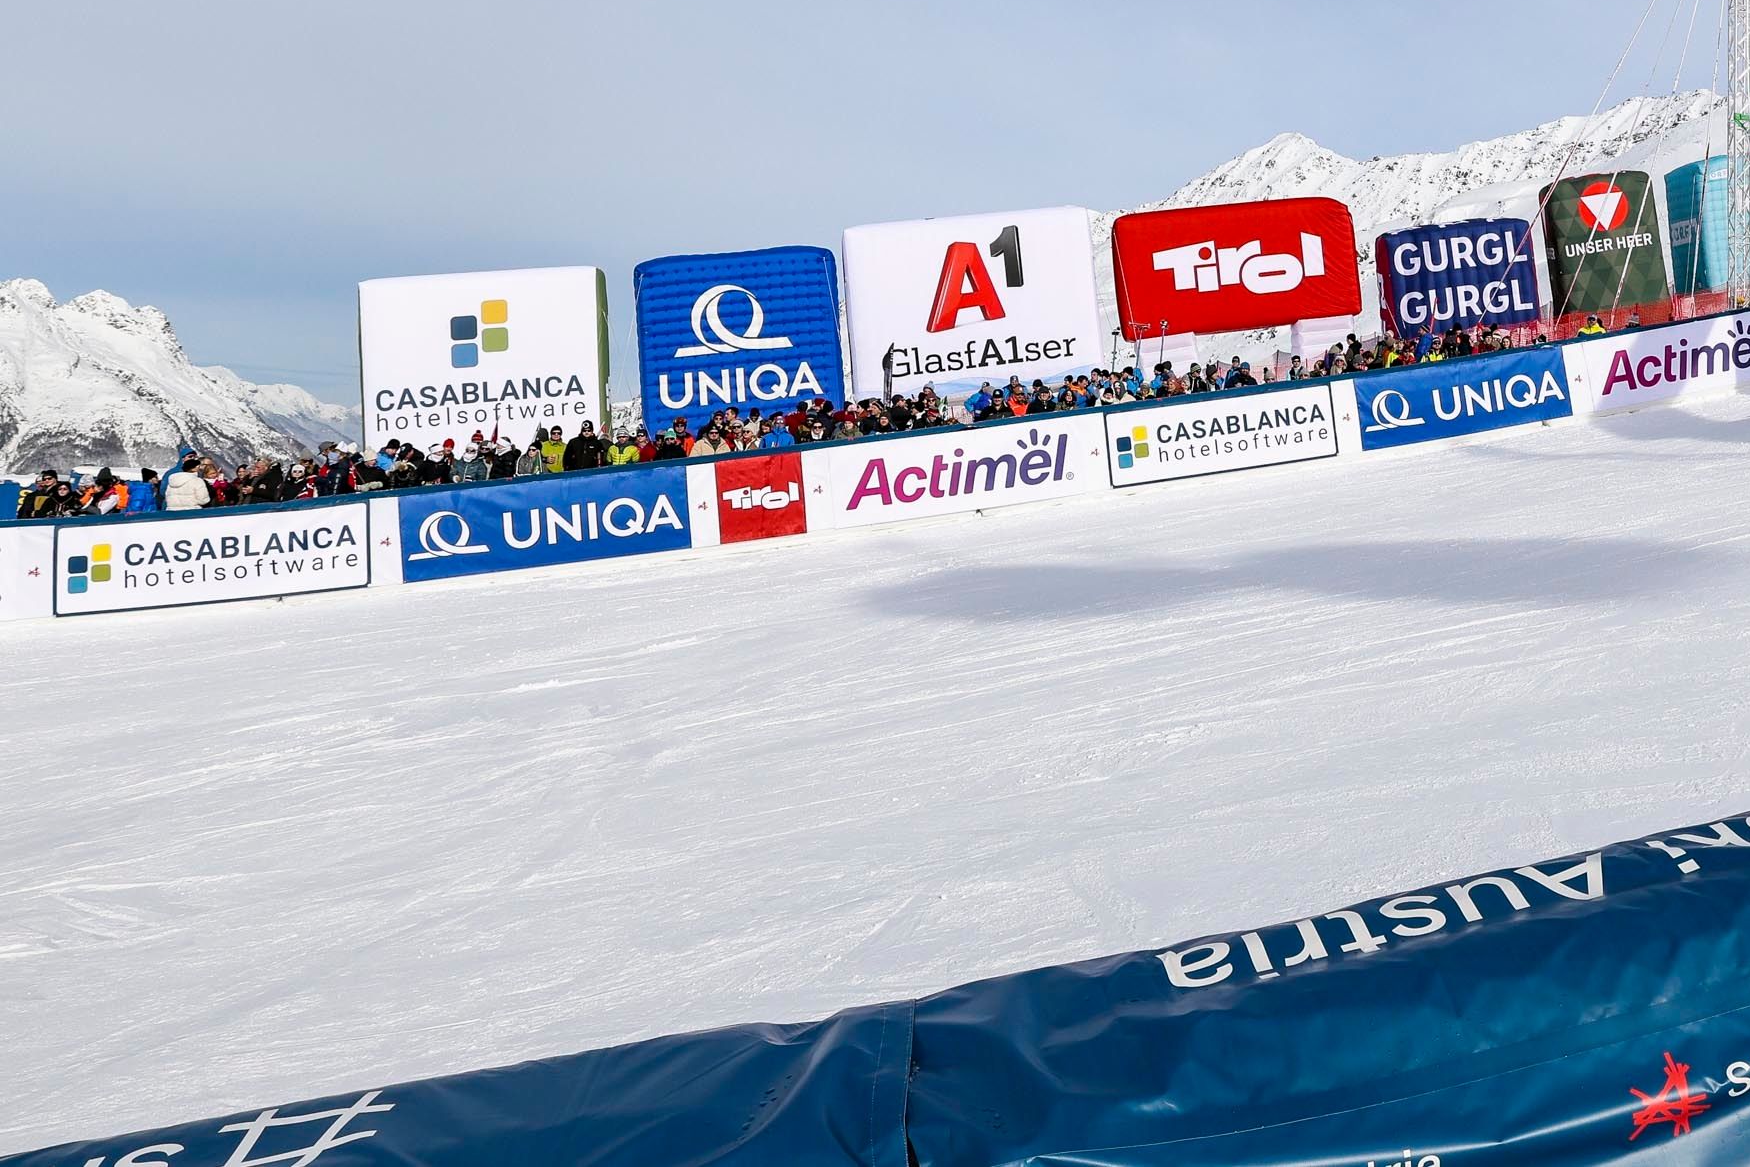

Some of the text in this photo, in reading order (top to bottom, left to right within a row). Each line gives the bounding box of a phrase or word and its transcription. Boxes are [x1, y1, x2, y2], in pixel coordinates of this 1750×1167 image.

[1152, 231, 1326, 295] Tirol
[1394, 231, 1527, 276] GURGL
[1565, 238, 1614, 258] UNSER
[1616, 233, 1653, 249] HEER
[926, 225, 1025, 333] A1
[1401, 279, 1533, 325] GURGL
[889, 337, 1077, 378] GlasfA1ser
[375, 374, 586, 412] CASABLANCA
[658, 361, 824, 409] UNIQA
[1433, 370, 1565, 423] UNIQA
[376, 398, 587, 432] hotelsoftware
[1156, 403, 1326, 446] CASABLANCA
[1157, 425, 1328, 463] hotelsoftware
[722, 481, 799, 511] Tirol
[503, 494, 684, 550] UNIQA
[124, 524, 357, 566] CASABLANCA
[124, 550, 358, 589] hotelsoftware
[1156, 851, 1604, 990] Austria
